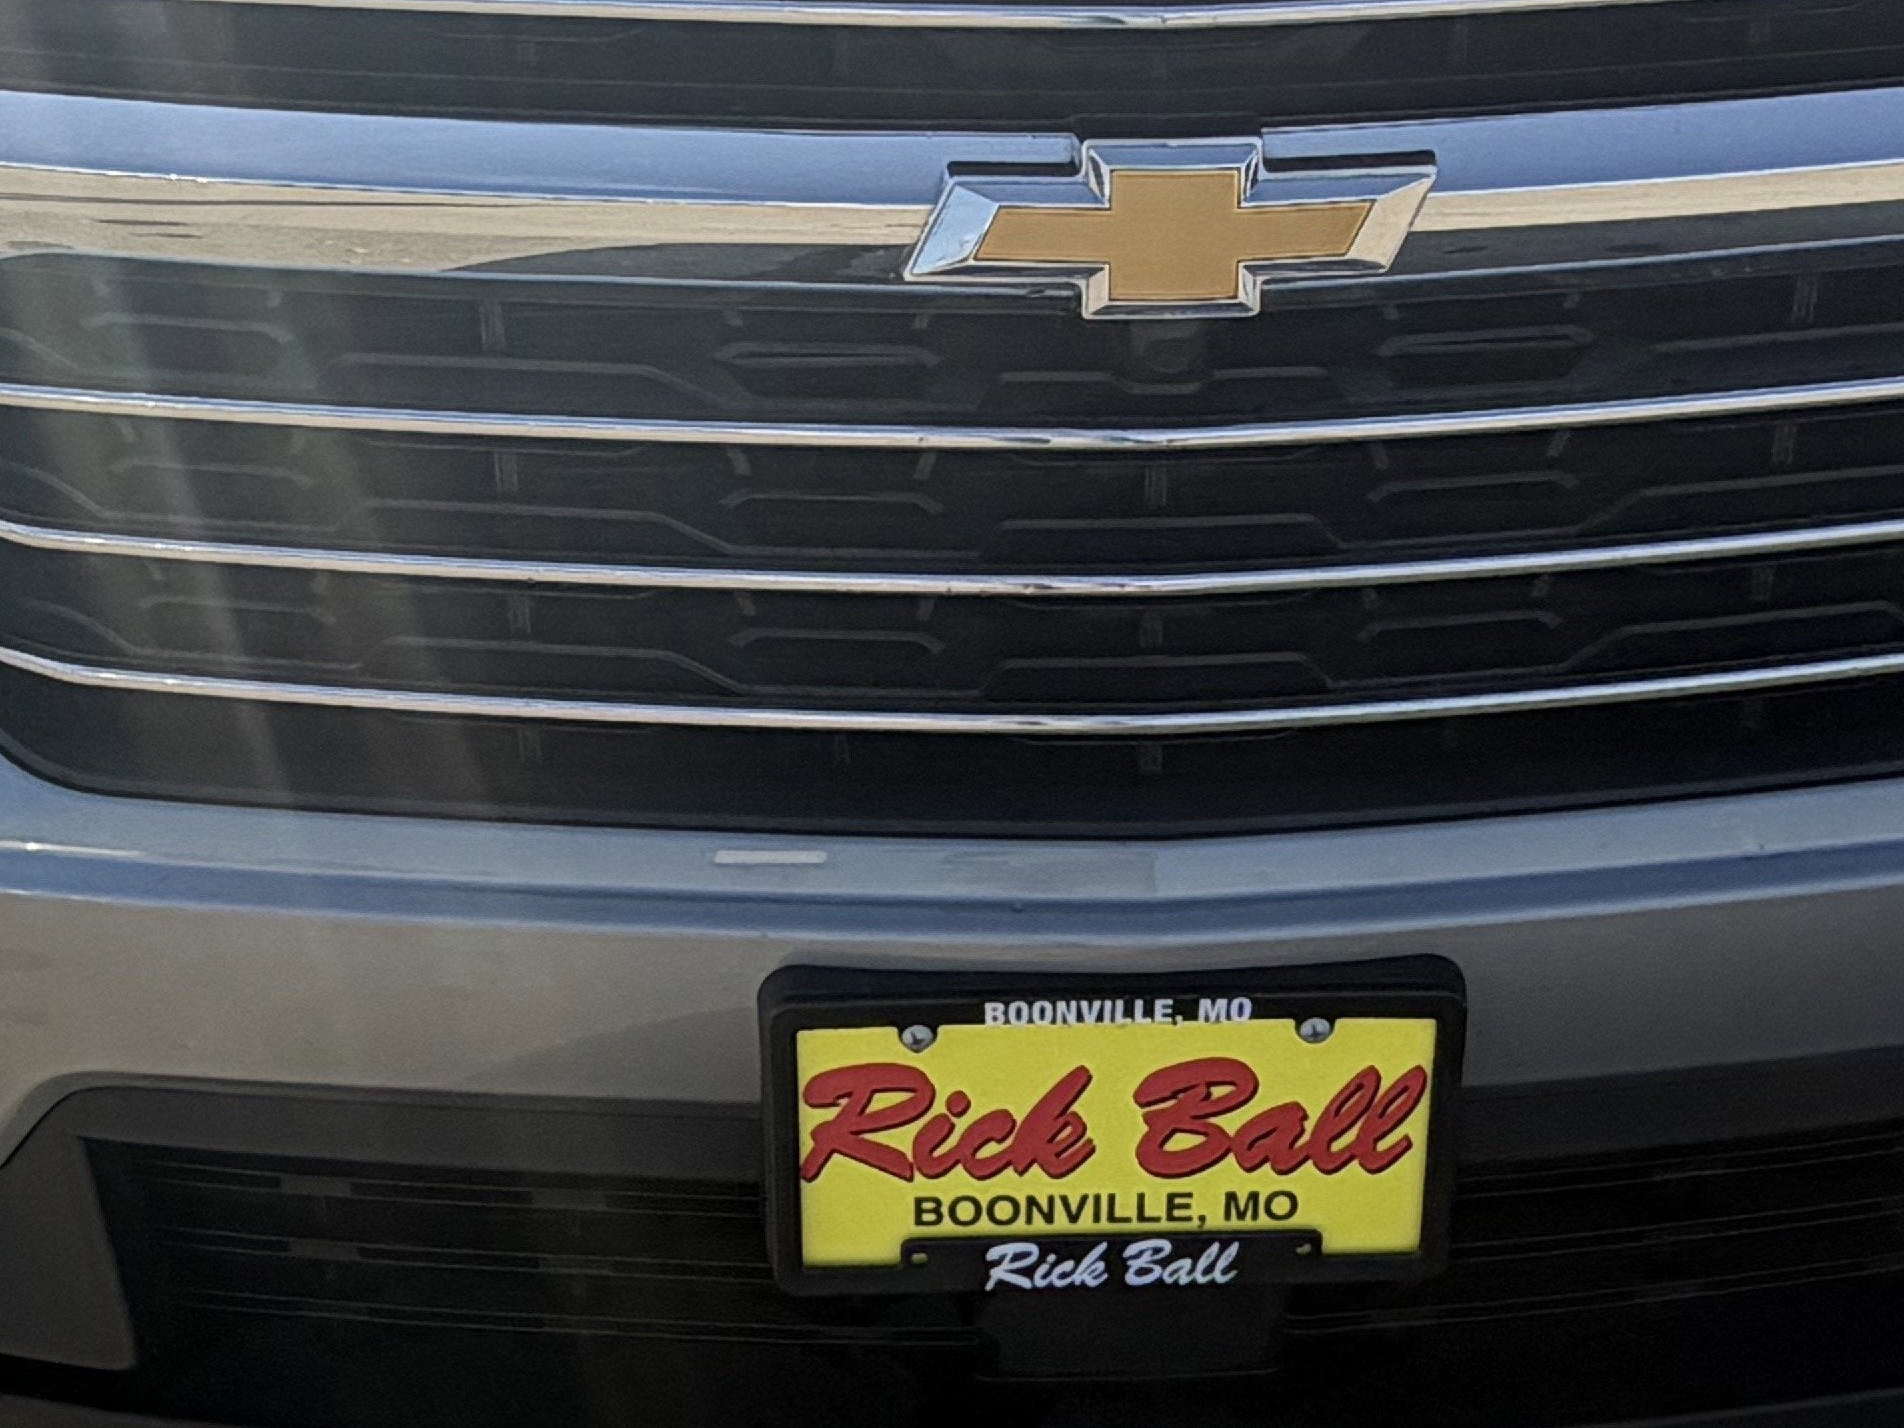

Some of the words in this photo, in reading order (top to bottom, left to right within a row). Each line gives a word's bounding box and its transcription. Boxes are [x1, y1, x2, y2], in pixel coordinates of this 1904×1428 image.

[984, 998, 1183, 1027] BOONVILLE,
[1198, 997, 1252, 1024] MO
[799, 1061, 1096, 1182] Rick
[1133, 1056, 1428, 1181] Ball
[913, 1192, 1206, 1228] BOONVILLE,
[1223, 1190, 1299, 1223] MO
[985, 1239, 1110, 1291] Rick
[1122, 1240, 1240, 1286] Ball
